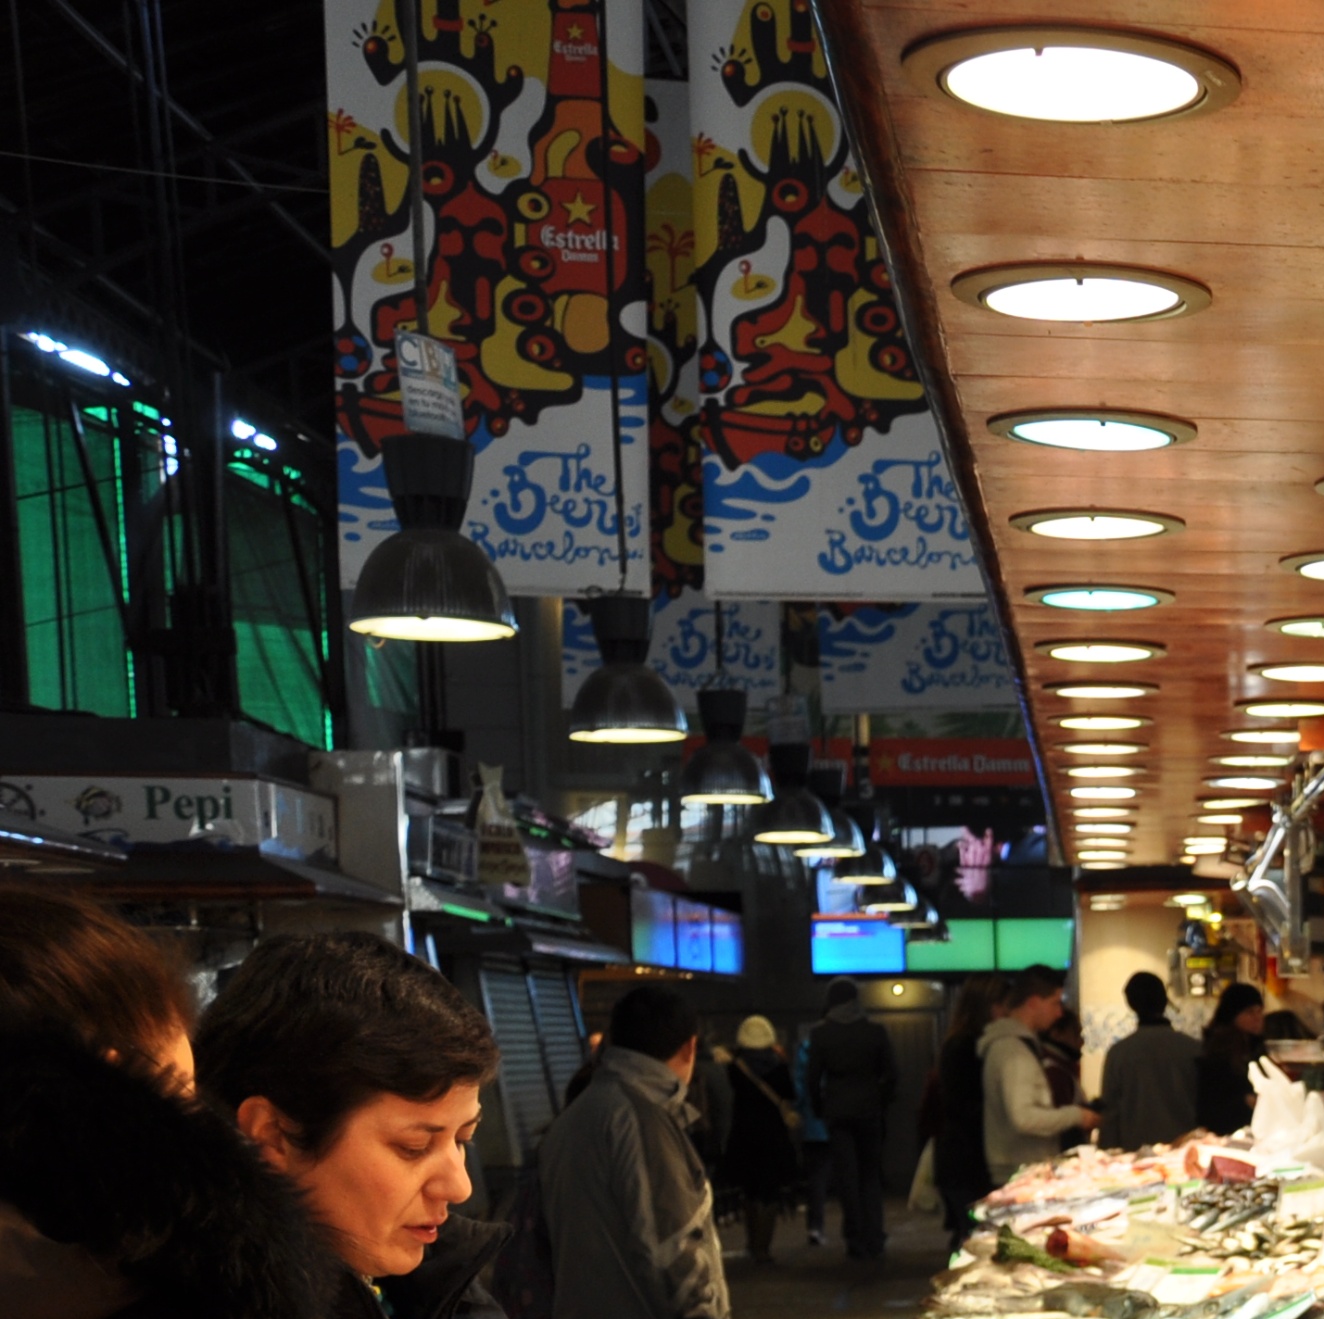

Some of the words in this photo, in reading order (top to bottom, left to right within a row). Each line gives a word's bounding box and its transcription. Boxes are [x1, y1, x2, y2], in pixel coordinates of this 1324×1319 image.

[518, 443, 617, 496] The
[817, 528, 979, 575] Barcelon
[142, 784, 233, 829] Pepi
